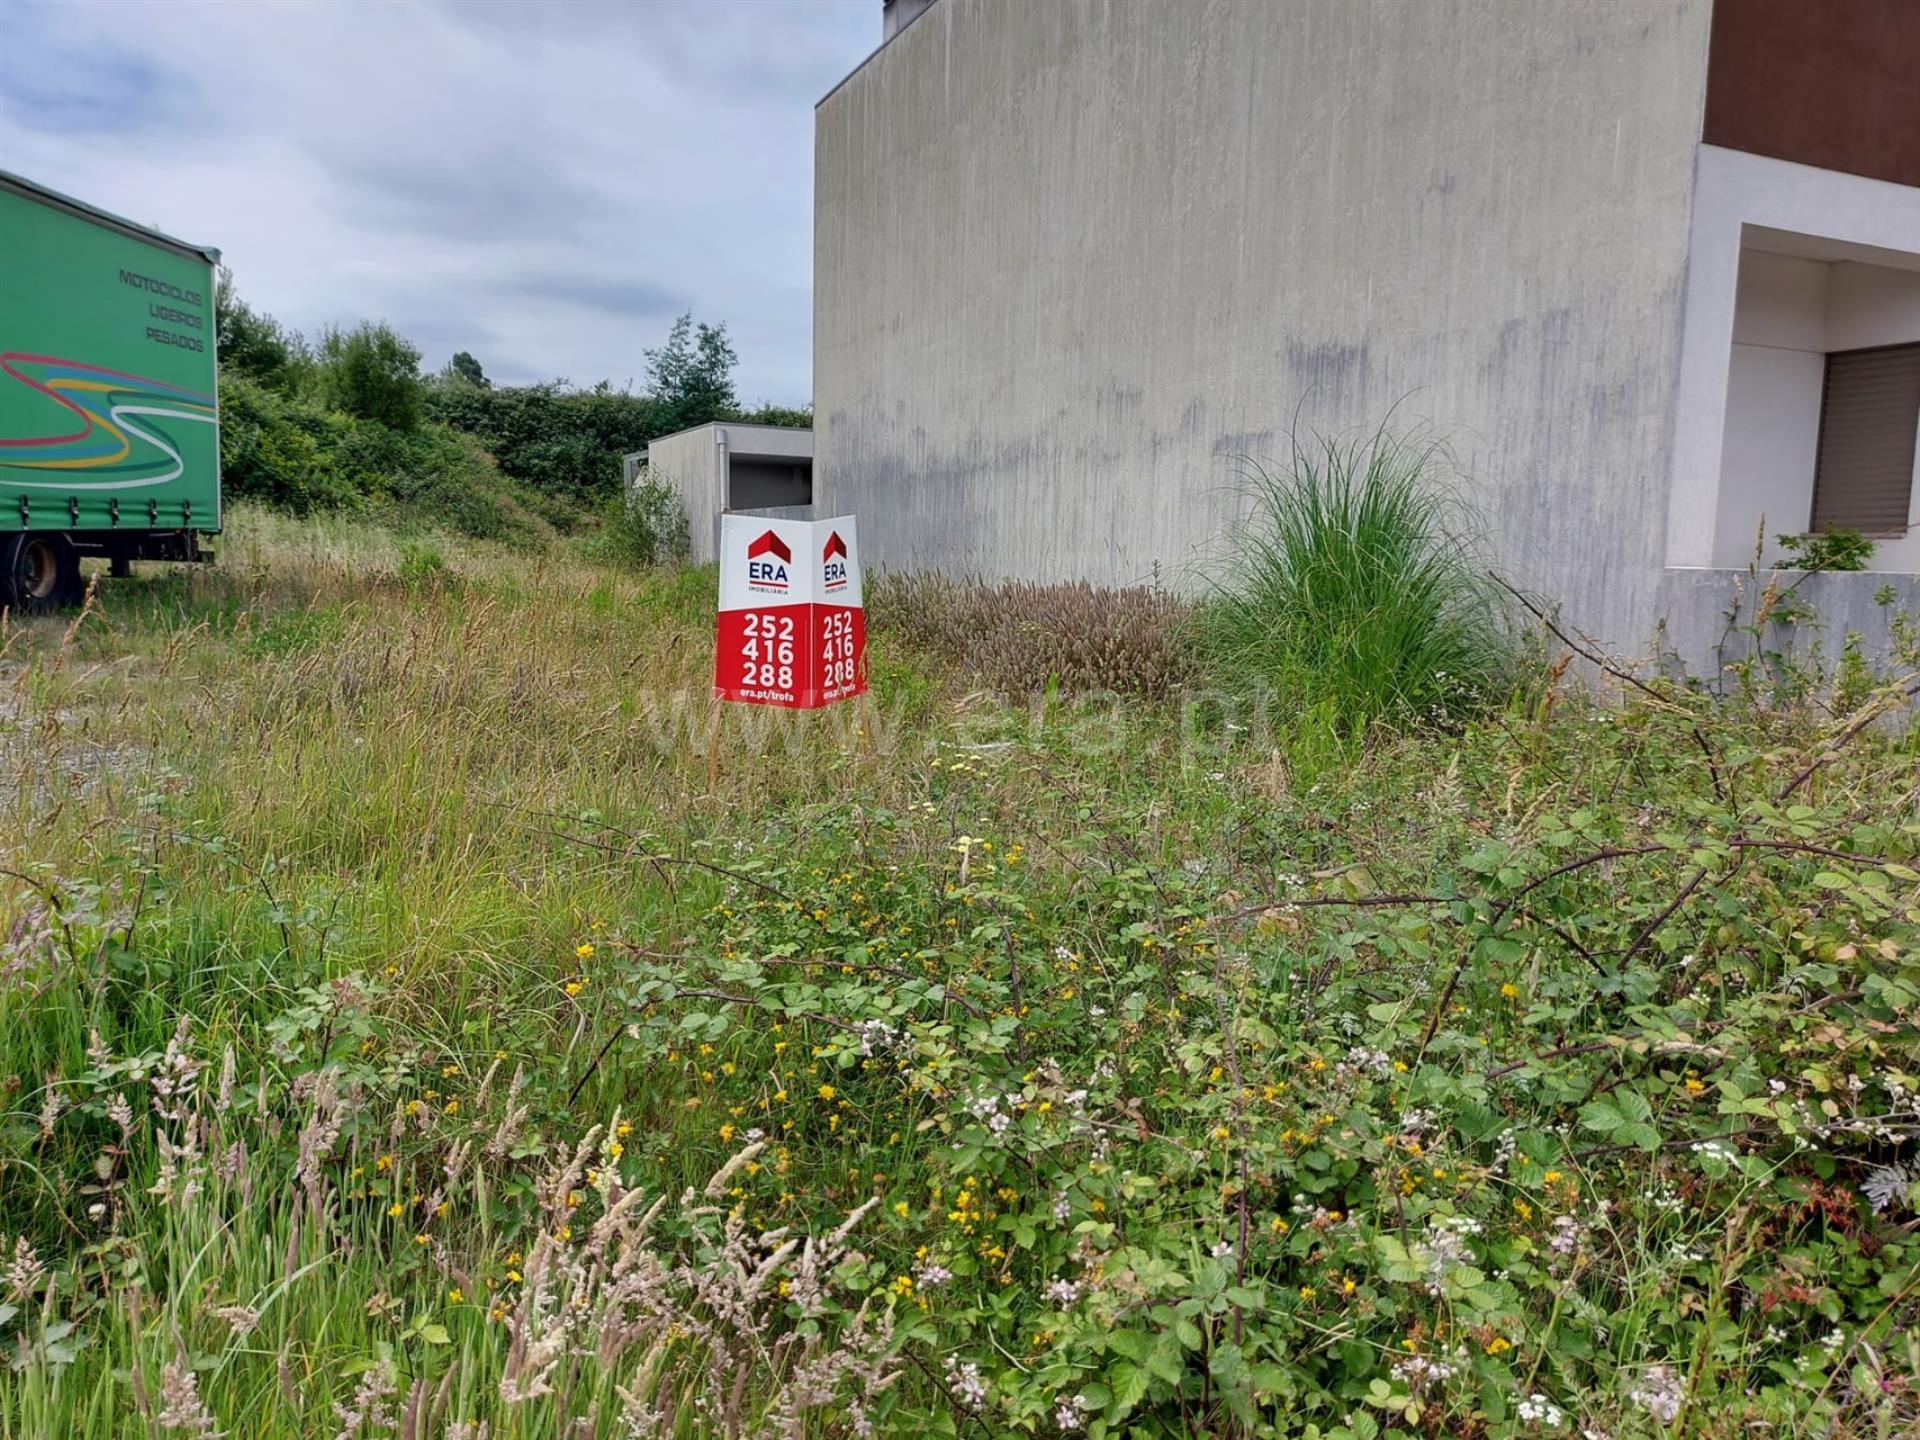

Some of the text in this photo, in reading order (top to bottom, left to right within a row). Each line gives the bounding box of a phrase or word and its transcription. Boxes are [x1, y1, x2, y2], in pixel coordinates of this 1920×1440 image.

[120, 269, 202, 307] MOTOCICLOS
[149, 302, 202, 330] LIGEIROS
[146, 326, 204, 353] PESADOS
[749, 562, 788, 582] ERA
[824, 562, 847, 582] ERA
[743, 613, 794, 641] 252
[823, 611, 852, 640] 252
[741, 637, 794, 665] 416
[823, 634, 853, 662] 416
[742, 662, 793, 689] 288
[824, 658, 854, 687] 288
[740, 689, 794, 702] era.pt/trofa
